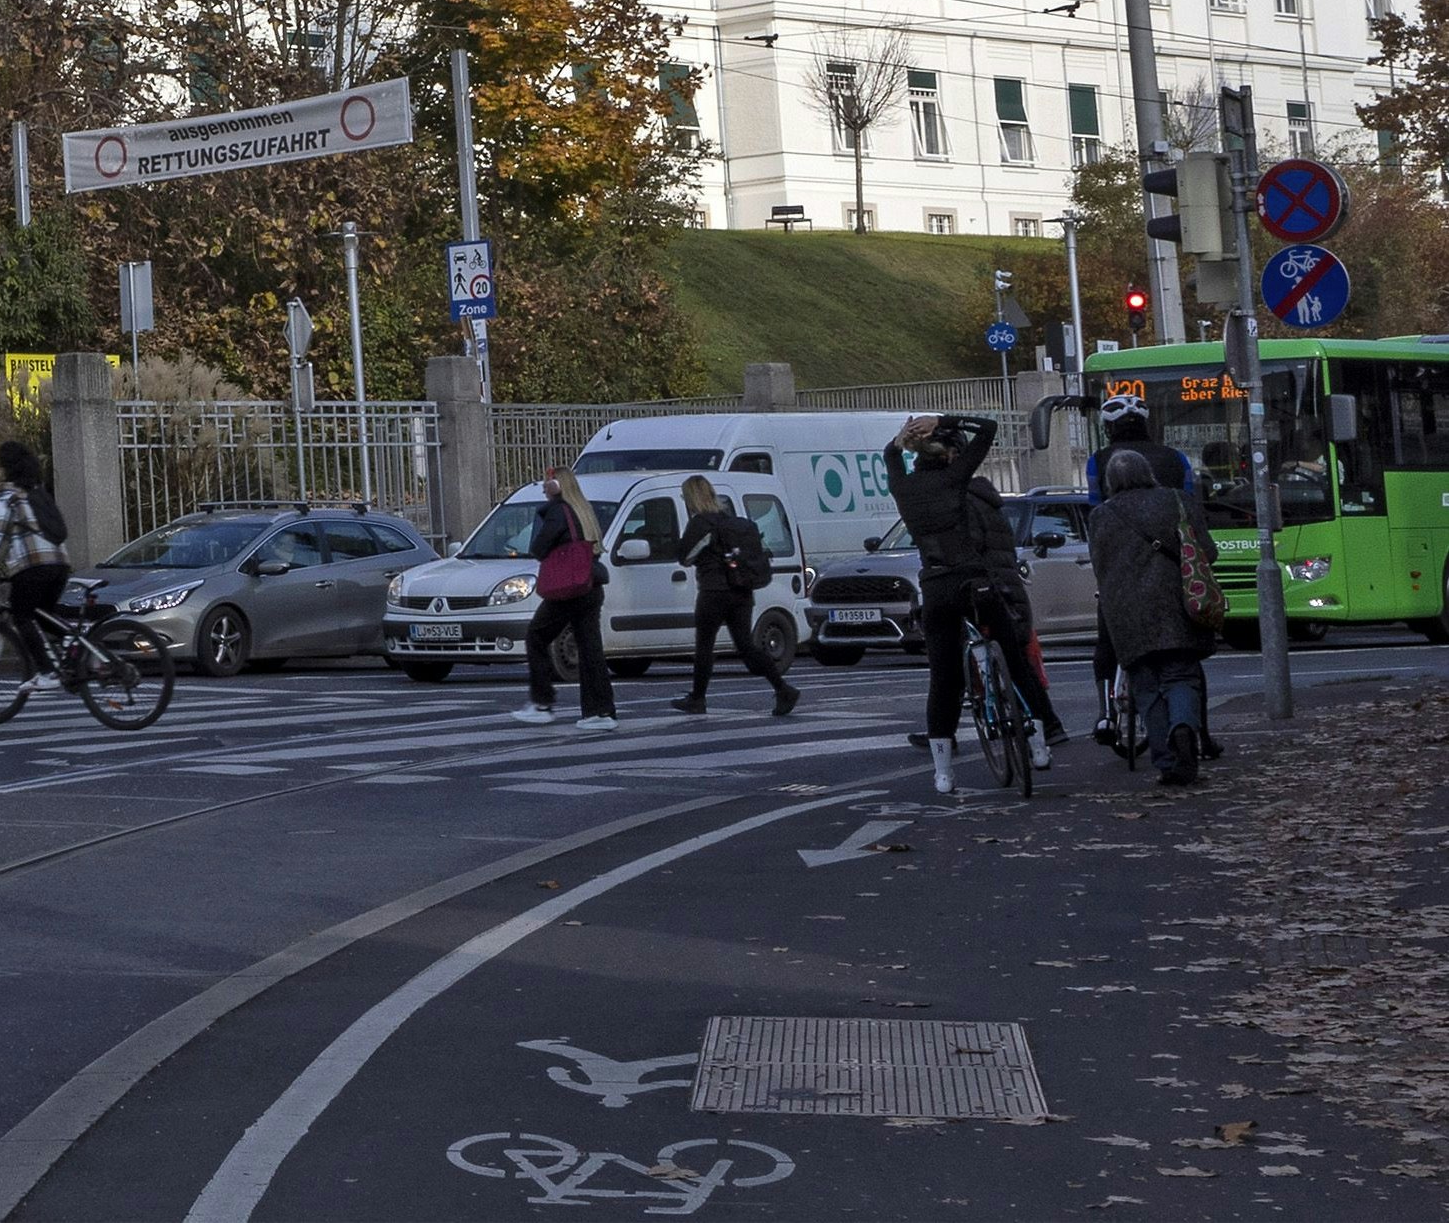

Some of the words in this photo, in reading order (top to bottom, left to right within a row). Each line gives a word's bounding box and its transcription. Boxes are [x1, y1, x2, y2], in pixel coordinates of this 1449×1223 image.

[168, 110, 294, 142] ausgenommen
[138, 128, 331, 175] RETTUNGSZUFAHRT
[475, 281, 488, 295] 20
[459, 304, 487, 316] Zone
[1182, 376, 1219, 389] Graz
[1181, 388, 1216, 401] über
